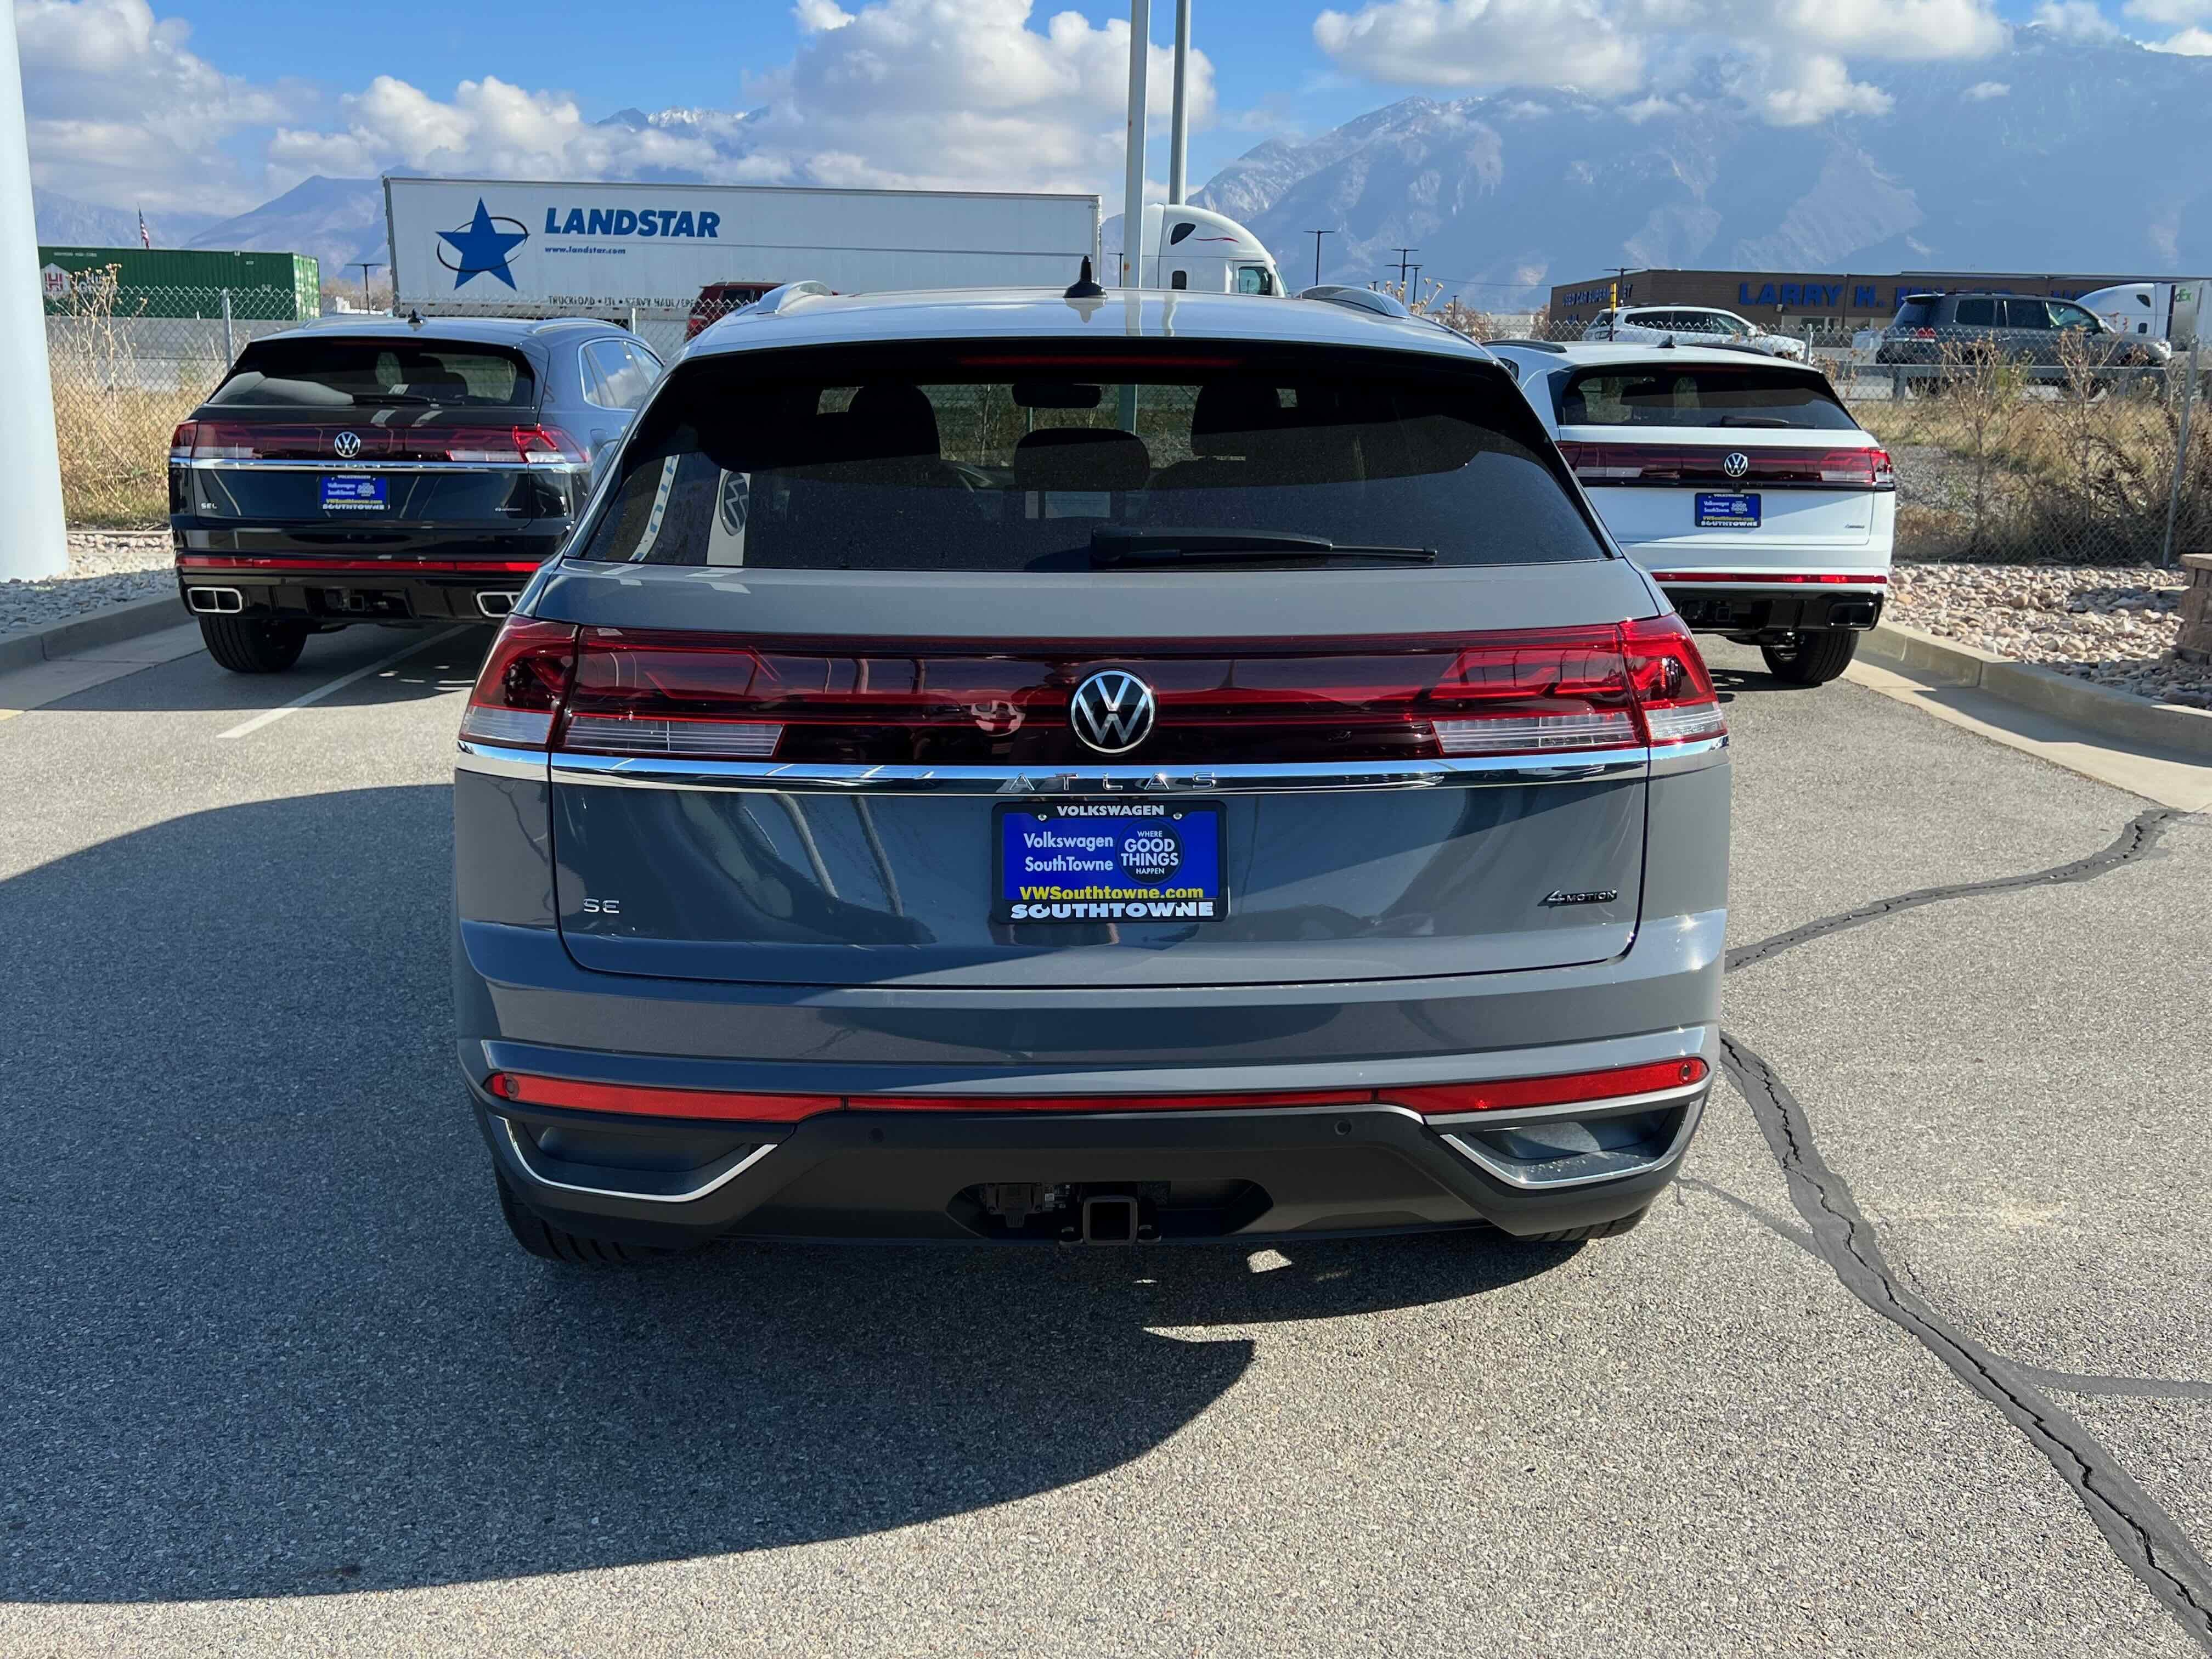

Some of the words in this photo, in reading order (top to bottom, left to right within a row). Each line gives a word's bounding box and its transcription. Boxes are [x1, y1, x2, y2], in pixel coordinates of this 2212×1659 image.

[544, 208, 720, 237] LANDSTAR
[545, 246, 626, 255] www.landstar.com
[548, 295, 595, 306] TRUCKLOAD
[1739, 282, 1843, 307] LARRY
[1854, 284, 1886, 308] H.
[1074, 673, 1152, 749] VW
[1009, 771, 1216, 791] ATLAS
[1057, 805, 1165, 816] VOLKSWAGEN
[1024, 832, 1114, 851] Volkswagen
[1125, 838, 1175, 853] GOOD
[1025, 856, 1114, 872] SouthTowne
[1120, 853, 1178, 866] THINGS
[1019, 885, 1204, 900] VWSouthtowne.com
[1537, 889, 1618, 909] 4MOTION
[583, 898, 619, 913] SE
[1011, 902, 1214, 919] SOUTHTOWNE
